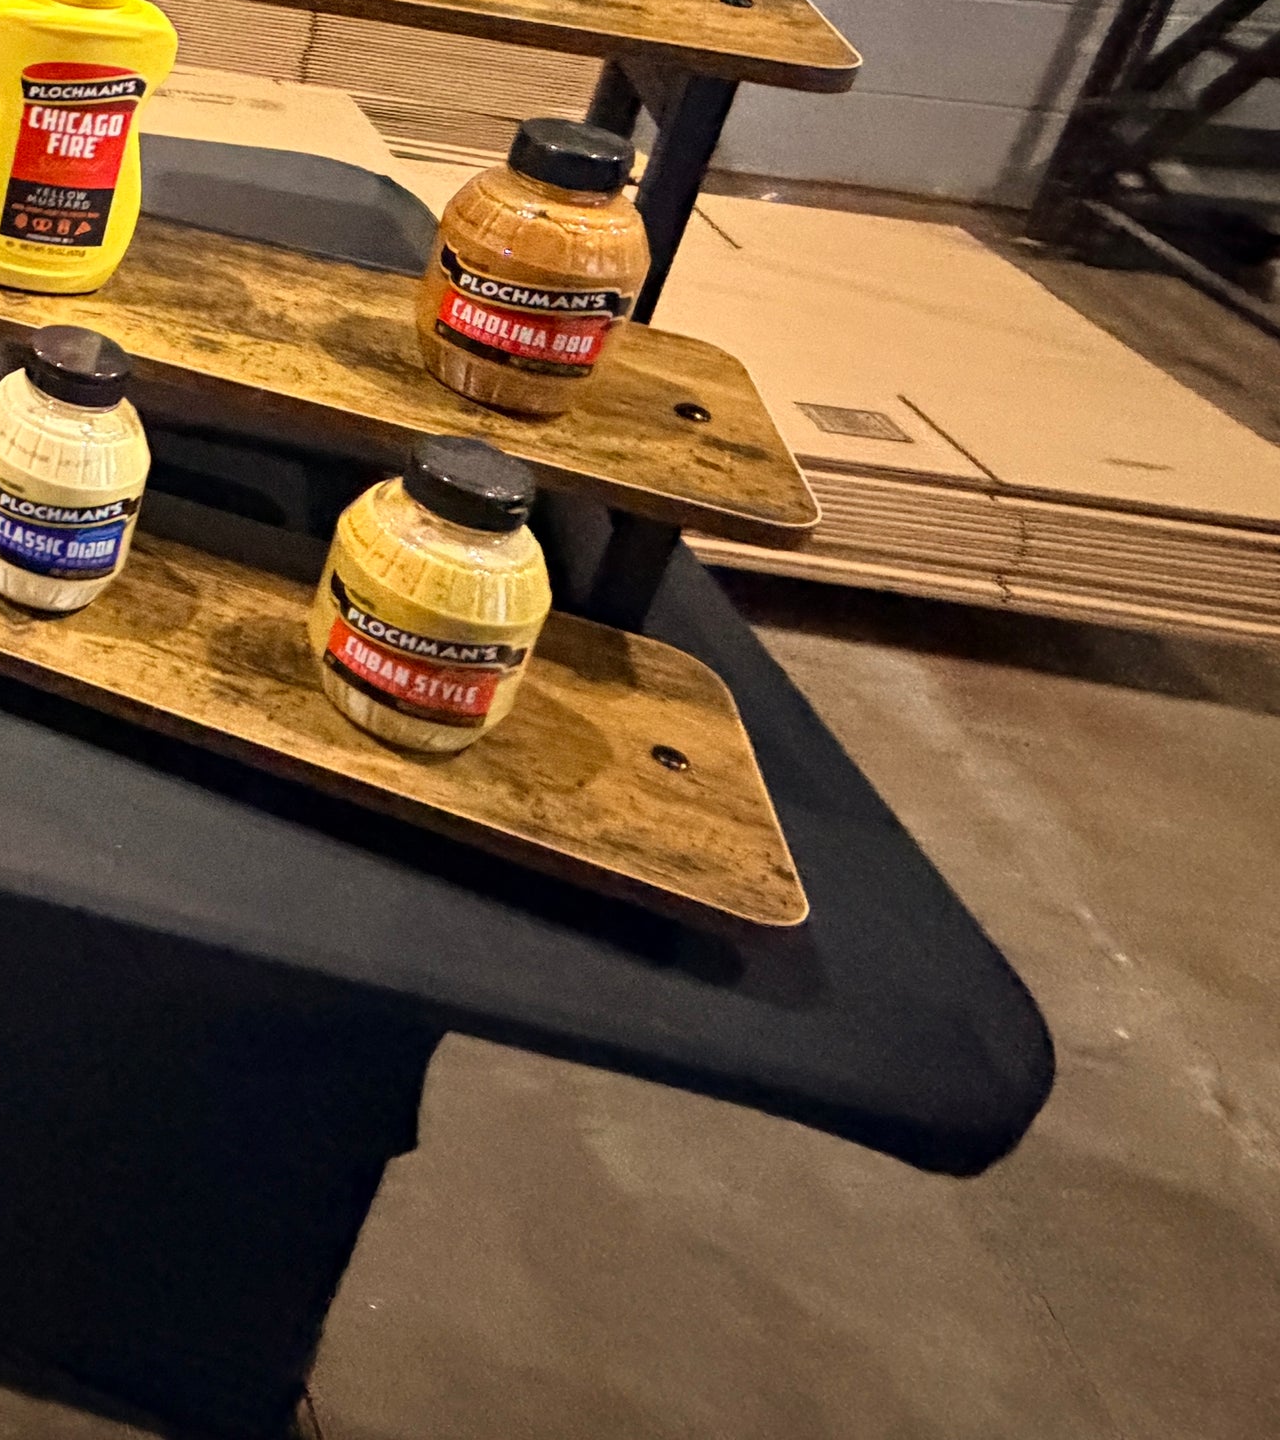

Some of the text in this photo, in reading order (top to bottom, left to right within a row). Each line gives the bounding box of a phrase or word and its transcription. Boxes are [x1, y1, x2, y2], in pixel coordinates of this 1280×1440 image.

[29, 80, 137, 99] PLOCHMAN'S
[28, 106, 124, 137] CHICAGO
[46, 134, 98, 159] FIRE
[26, 194, 92, 210] MUSTARD
[36, 187, 88, 200] YELLOW
[459, 273, 606, 309] PLOCHMAN'S
[451, 298, 547, 348] CAROLINA
[0, 492, 124, 523] PLOCHMAN'S
[66, 538, 117, 558] DIJON
[347, 607, 499, 660] PLOCHMAN'S
[345, 635, 411, 687] CUBAN
[413, 673, 481, 705] STYLE
